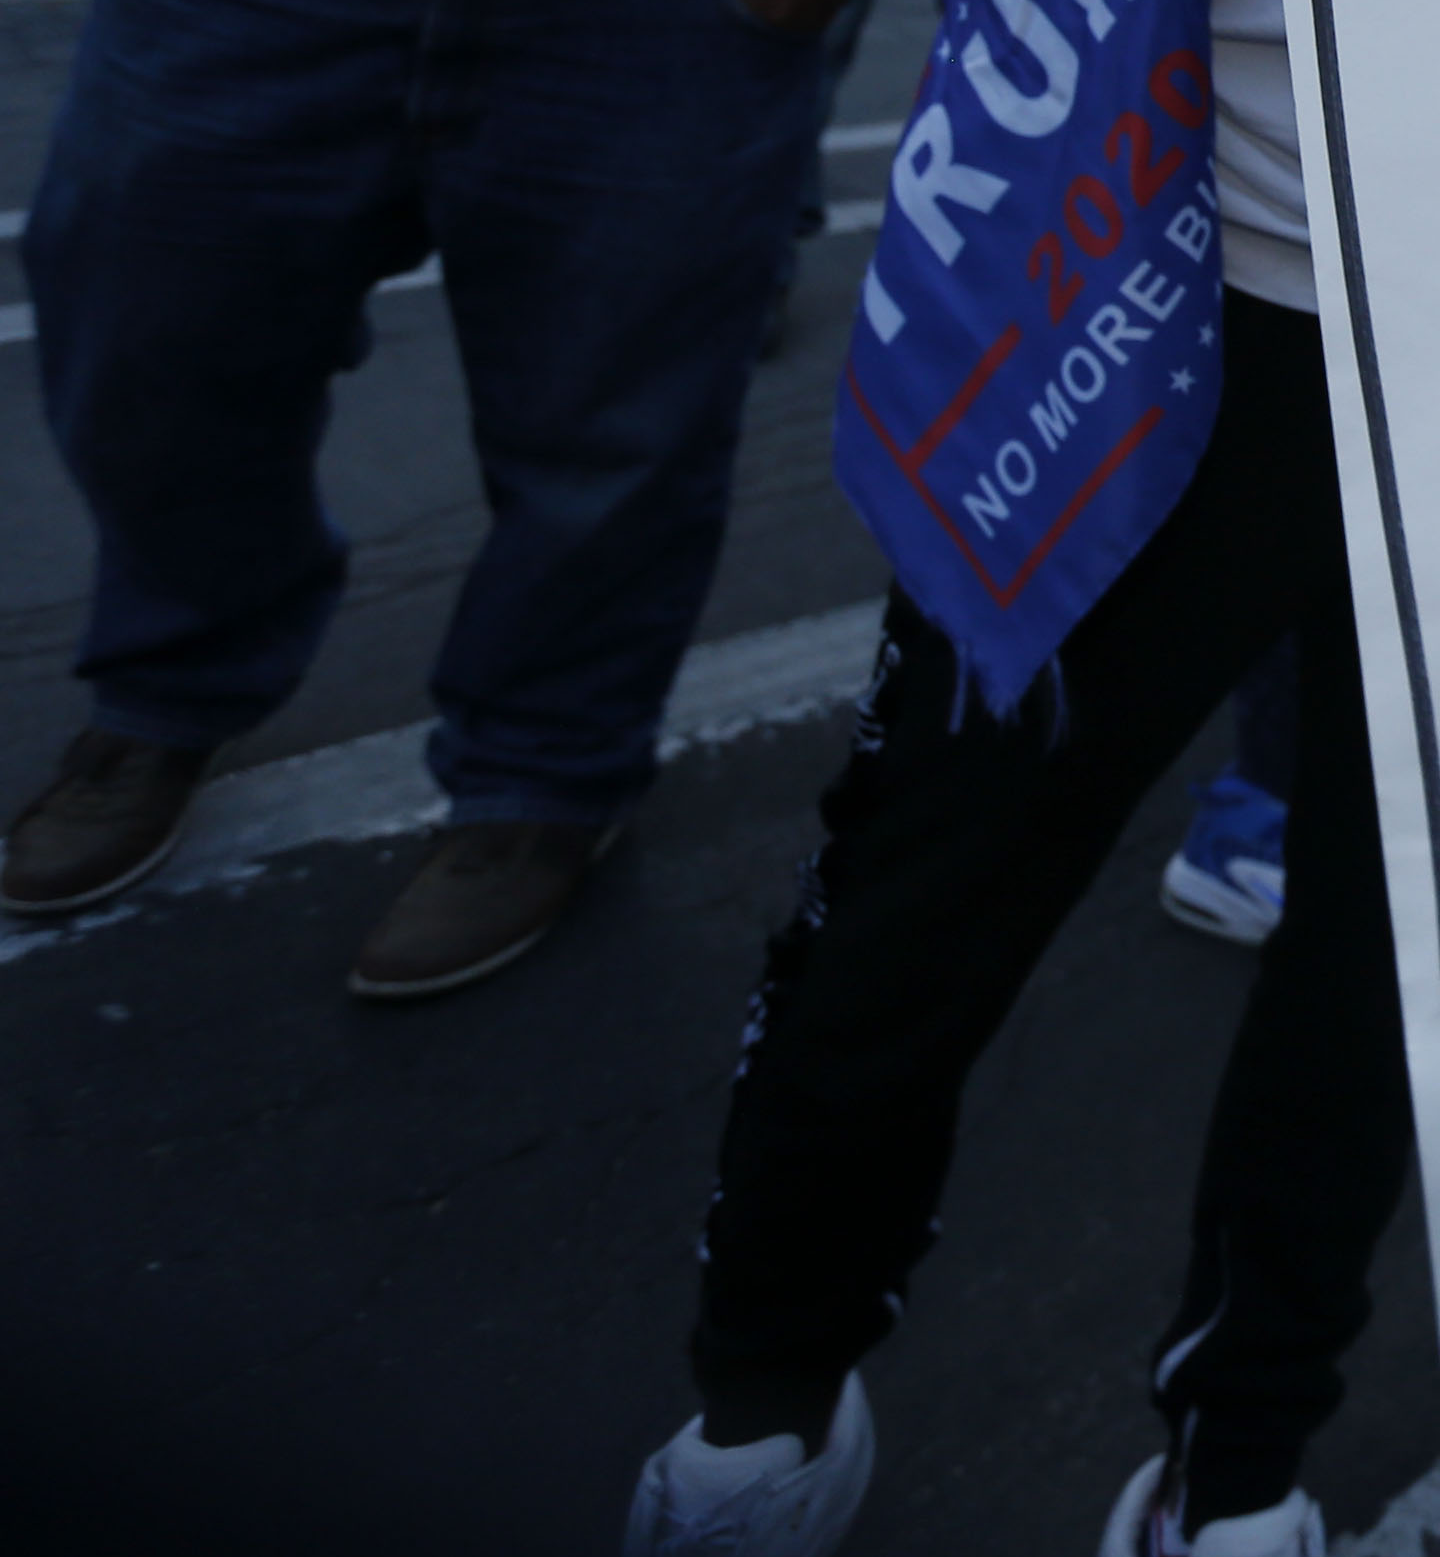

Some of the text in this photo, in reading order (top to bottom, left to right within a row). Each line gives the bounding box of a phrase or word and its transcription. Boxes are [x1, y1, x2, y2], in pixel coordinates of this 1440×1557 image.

[1029, 49, 1210, 325] 2020
[961, 439, 1038, 540] NO
[1028, 260, 1188, 453] MORE
